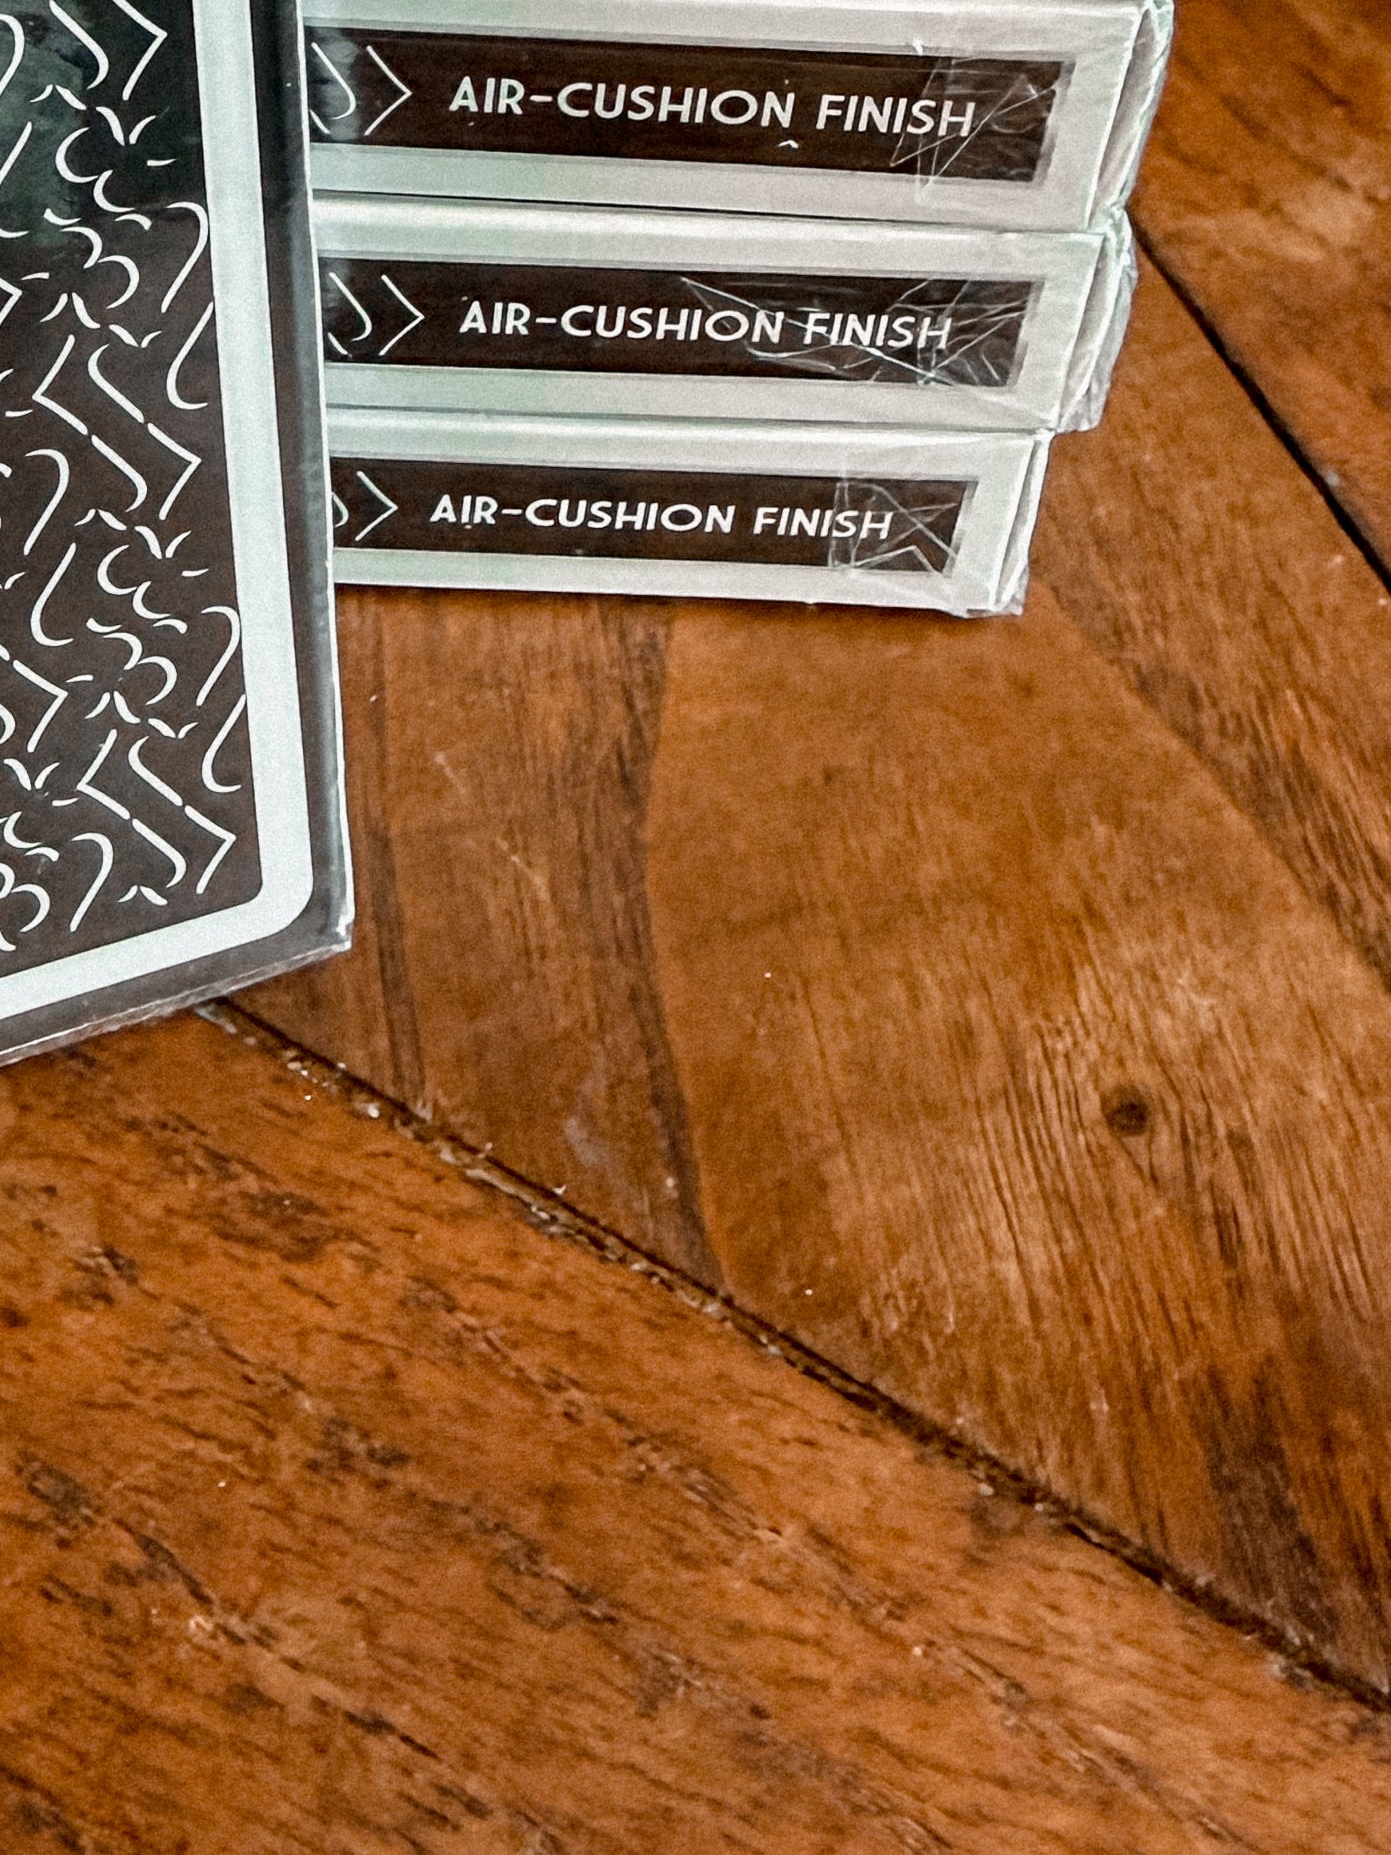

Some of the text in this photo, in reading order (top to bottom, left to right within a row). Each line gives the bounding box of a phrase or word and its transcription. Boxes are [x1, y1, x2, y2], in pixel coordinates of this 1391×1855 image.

[450, 75, 976, 139] AIR-CUSHION FINISH
[459, 300, 952, 351] AIR-CUSHION FINISH
[430, 493, 893, 543] AIR-CUSHION FINISH
